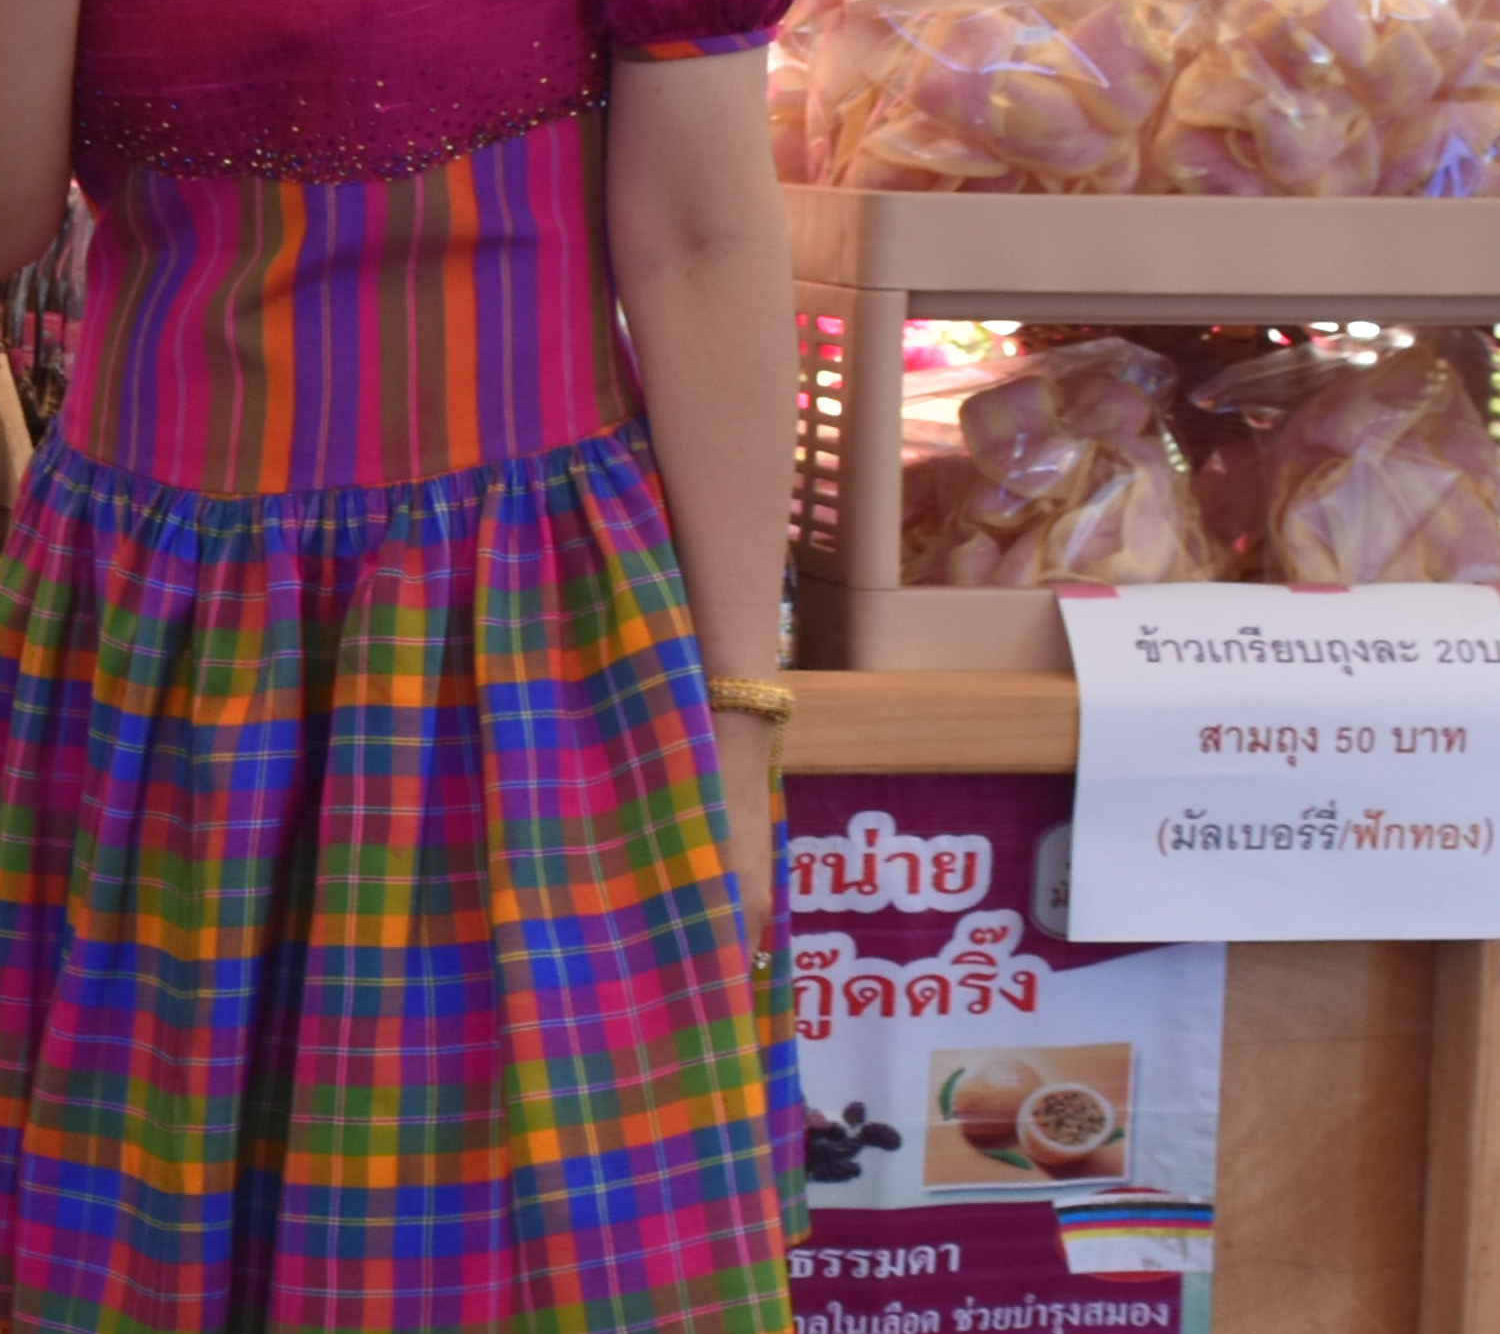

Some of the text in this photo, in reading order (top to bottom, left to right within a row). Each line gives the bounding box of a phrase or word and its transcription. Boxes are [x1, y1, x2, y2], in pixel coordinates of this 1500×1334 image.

[1135, 625, 1419, 676] ข้าวเกรียบถุงละ
[1198, 723, 1468, 767] สามถุง 50 บาท
[1157, 799, 1496, 857] (มัลเบอร์รี่/ฟักทอง)
[791, 828, 979, 896] หน่าย
